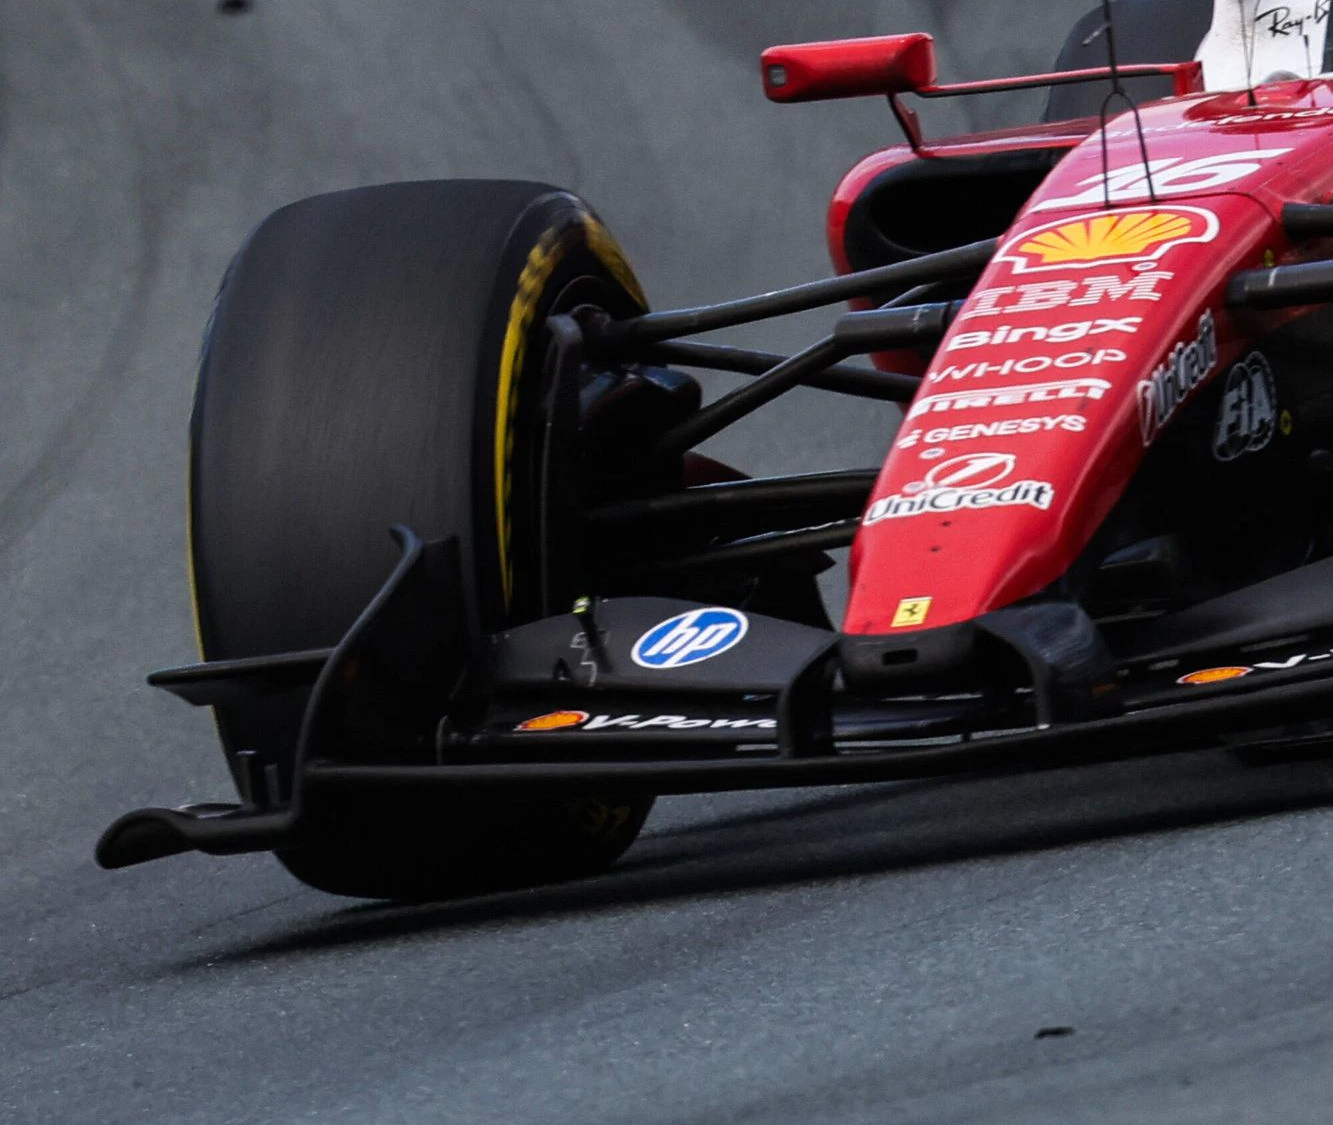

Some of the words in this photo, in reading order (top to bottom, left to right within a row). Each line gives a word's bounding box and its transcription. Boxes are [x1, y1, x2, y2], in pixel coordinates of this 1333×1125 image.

[1026, 147, 1297, 214] 16
[961, 271, 1175, 321] IBM
[928, 348, 1128, 383] WHOOP
[905, 377, 1113, 420] PIRELLI
[923, 414, 1088, 444] GENESYS
[864, 480, 1052, 523] UniCredit
[640, 607, 739, 667] hp
[582, 714, 778, 730] V-Pow
